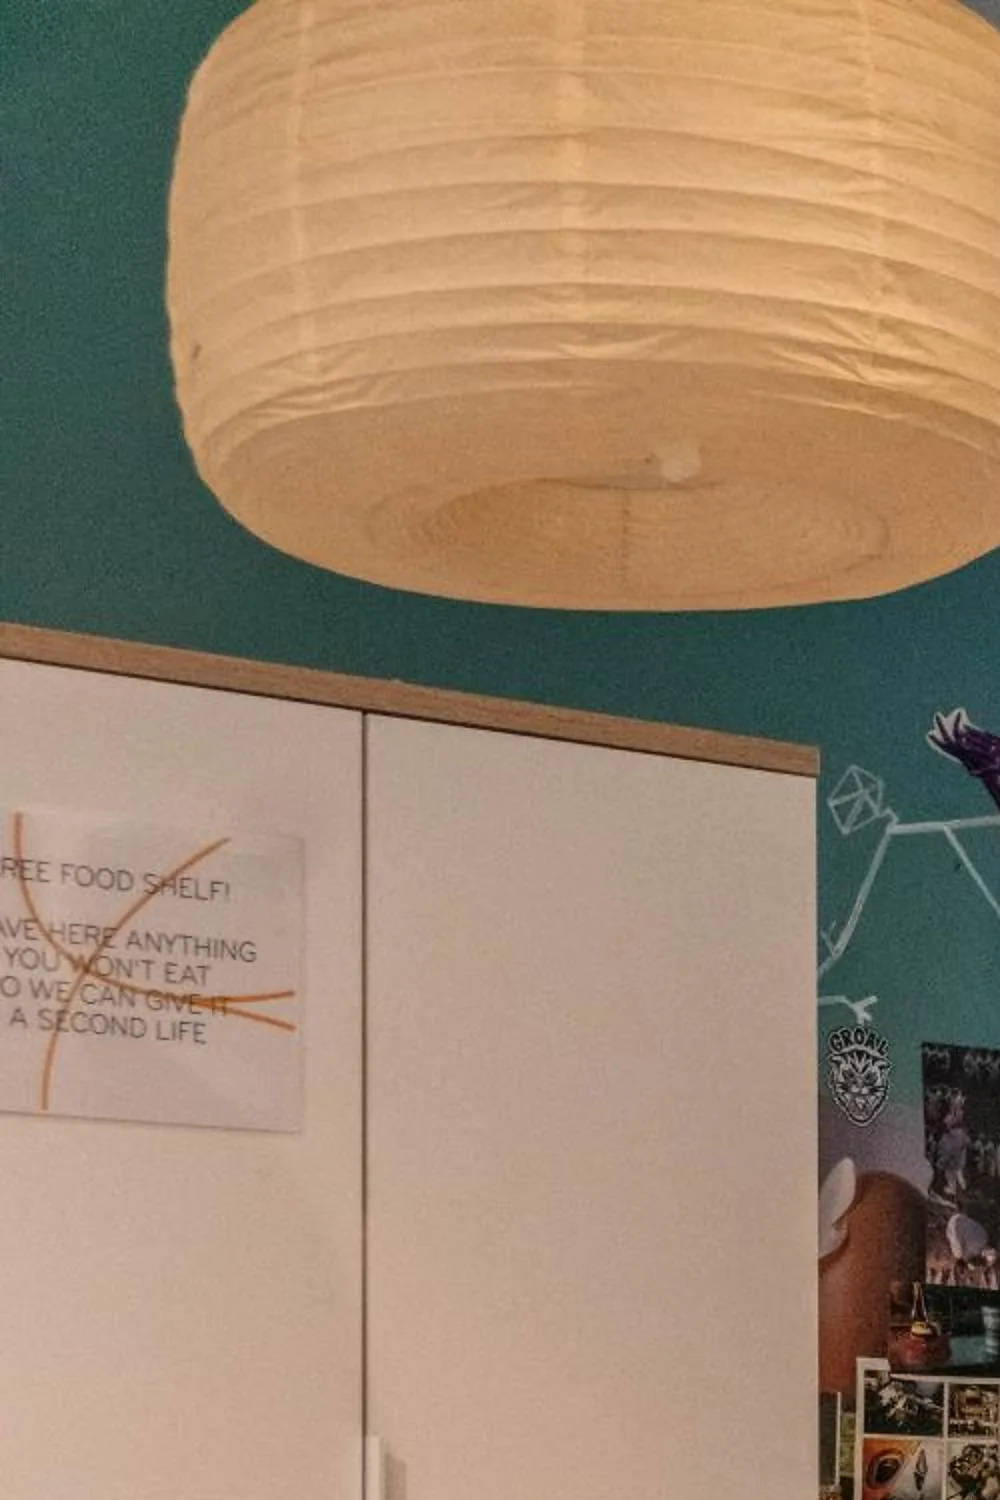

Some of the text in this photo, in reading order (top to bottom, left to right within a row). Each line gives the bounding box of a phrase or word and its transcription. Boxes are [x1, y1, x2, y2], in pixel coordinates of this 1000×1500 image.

[61, 863, 135, 891] FOOD
[50, 920, 118, 949] HERE
[126, 929, 258, 963] ANYTHING
[5, 948, 61, 973] YOU
[164, 962, 213, 986] EAT
[29, 978, 71, 1004] WE
[80, 983, 136, 1009] CAN
[146, 990, 203, 1015] GIVE
[8, 1008, 208, 1045] A SECOND LIFE
